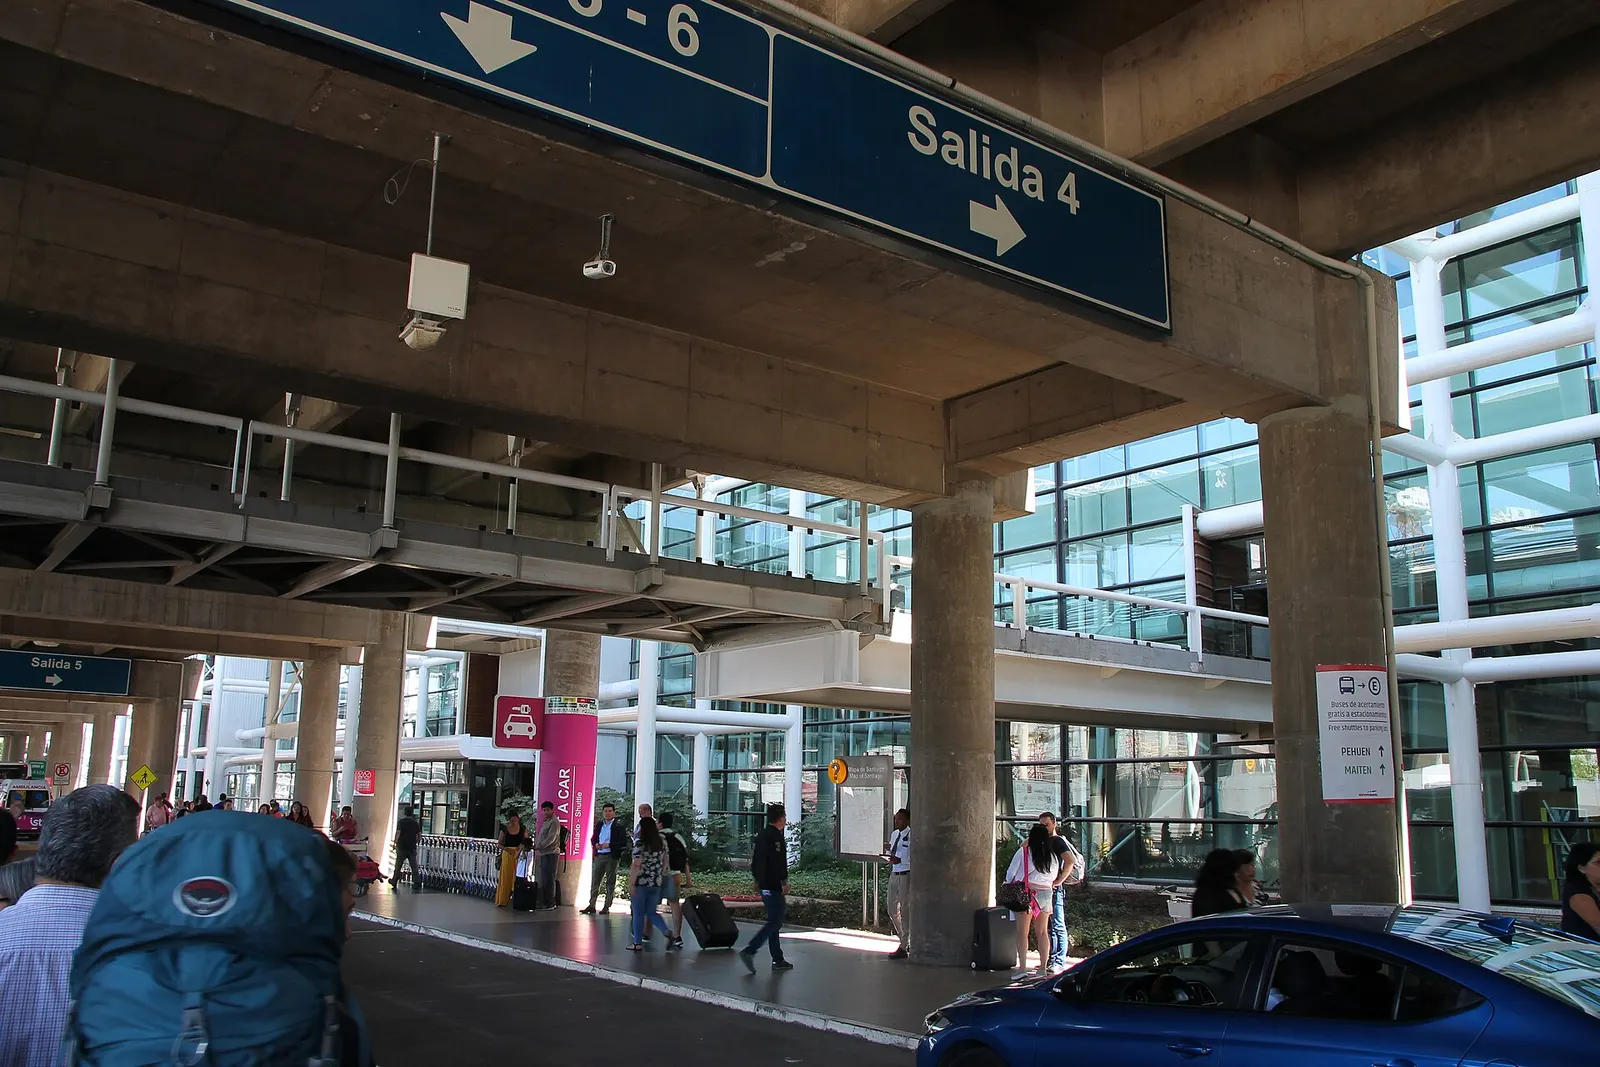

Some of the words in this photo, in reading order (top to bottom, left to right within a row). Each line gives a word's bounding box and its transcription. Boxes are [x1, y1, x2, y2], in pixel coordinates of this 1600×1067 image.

[667, 3, 700, 57] 6
[907, 105, 1045, 202] Salida
[1057, 171, 1080, 215] 4
[31, 657, 71, 669] Salida
[74, 660, 82, 670] 5
[1327, 711, 1346, 719] gratis
[1341, 747, 1371, 756] PEHUEN
[1344, 765, 1372, 775] MAITEN
[558, 769, 570, 799] CAR
[558, 803, 568, 813] A
[573, 824, 581, 855] Traslado
